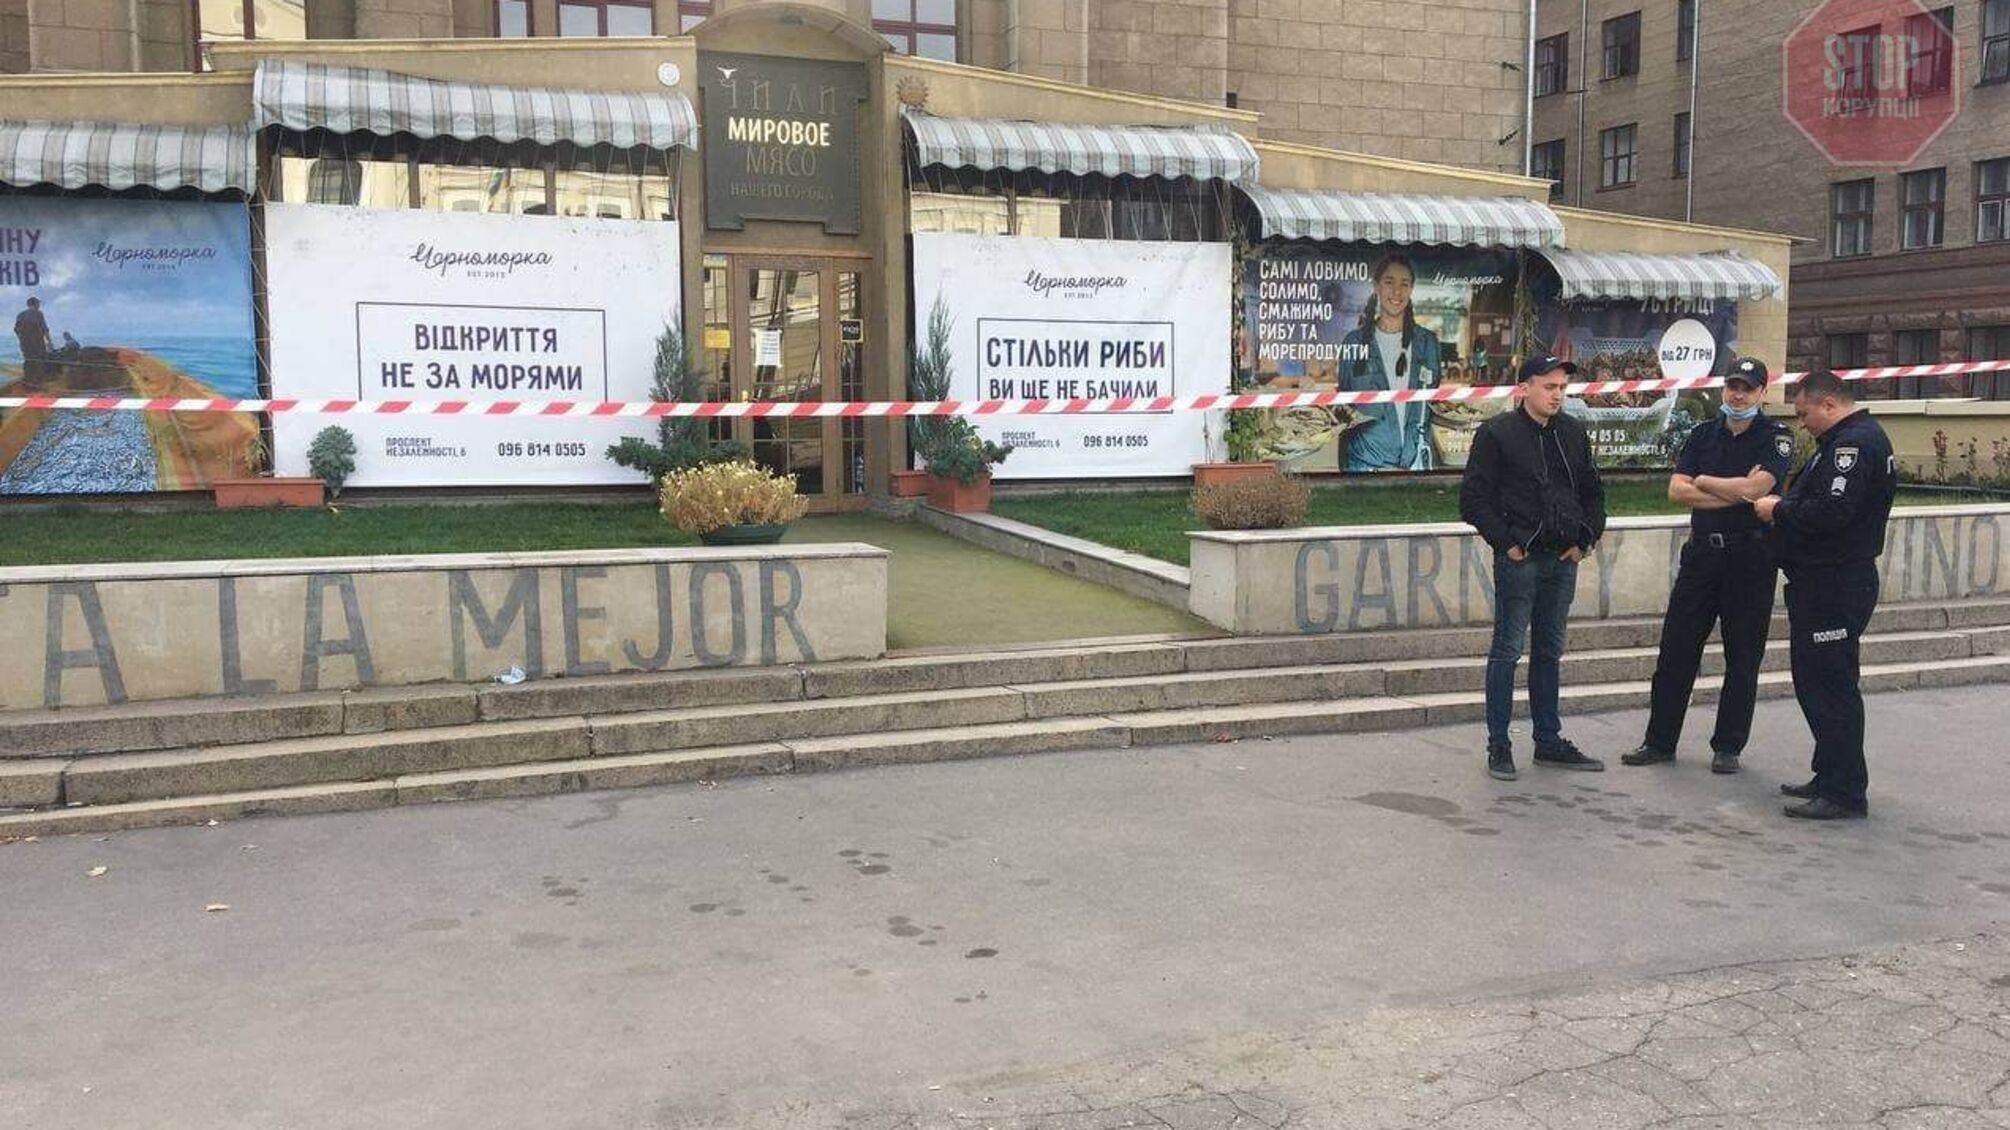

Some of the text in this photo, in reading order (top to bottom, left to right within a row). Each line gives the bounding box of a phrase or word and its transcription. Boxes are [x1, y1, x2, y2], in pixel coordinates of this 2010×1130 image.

[728, 117, 831, 146] МИРОВОЕ
[746, 146, 816, 176] МЯСО
[410, 243, 552, 277] Чорноморка
[1260, 260, 1373, 283] САМІ ЛОВИМО,
[1259, 282, 1322, 301] СОЛИМО,
[1258, 302, 1333, 320] СМАЖИМО
[415, 324, 557, 352] ВІДКРИТТЯ
[1258, 323, 1318, 340] РИБУ ТА
[987, 337, 1165, 368] СТІЛЬКИ РИБИ
[1258, 343, 1369, 360] МОРЕПРОДУКТИ
[1676, 345, 1690, 361] 27
[1692, 348, 1713, 361] ГРН
[381, 362, 582, 391] НЕ ЗА МОРЯМИ
[990, 379, 1158, 400] ВИ ЩЕ НЕ БАЧИЛИ
[386, 437, 431, 446] ПРОСПЕКТ
[498, 442, 586, 457] 096 814 0505
[1083, 435, 1149, 448] 096 814 0505
[219, 574, 375, 695] LA
[448, 557, 816, 683] MEJOR
